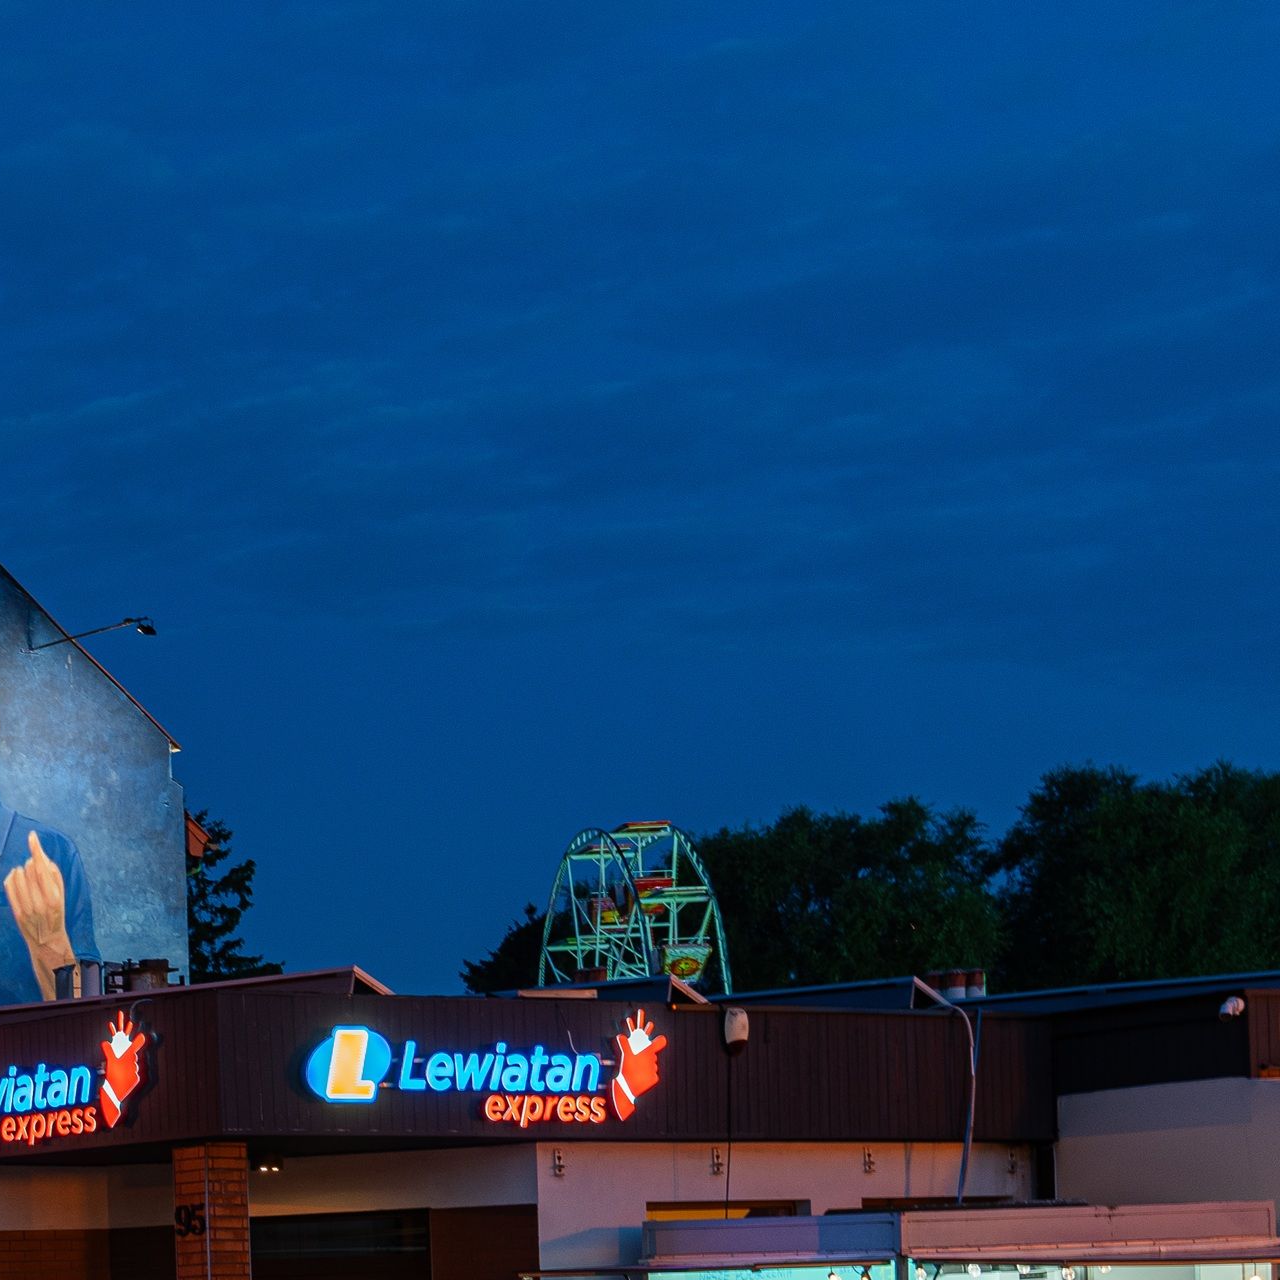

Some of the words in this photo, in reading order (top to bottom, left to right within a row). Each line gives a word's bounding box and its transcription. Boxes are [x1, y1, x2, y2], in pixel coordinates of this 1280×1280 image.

[399, 1039, 601, 1093] Lewiatan
[0, 1106, 98, 1147] express
[483, 1093, 608, 1129] express
[175, 1203, 207, 1237] 95
